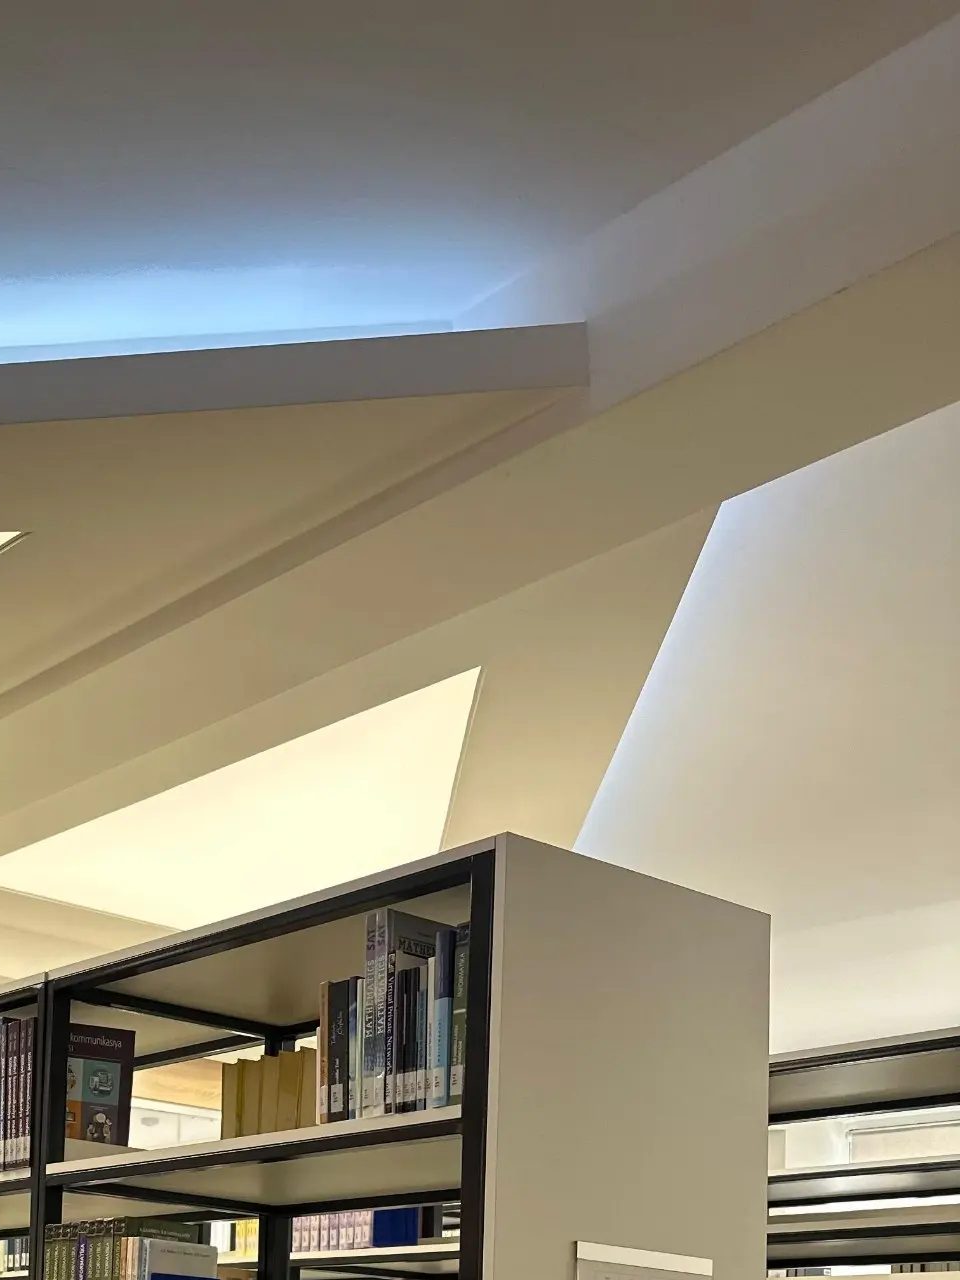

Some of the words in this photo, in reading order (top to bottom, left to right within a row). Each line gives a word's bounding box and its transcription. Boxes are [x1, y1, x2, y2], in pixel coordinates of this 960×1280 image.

[399, 938, 436, 957] MATHEM
[366, 960, 374, 1037] MATHEMATICS
[376, 955, 385, 1033] MATHEMATICS
[70, 1033, 122, 1050] kommunikasiya
